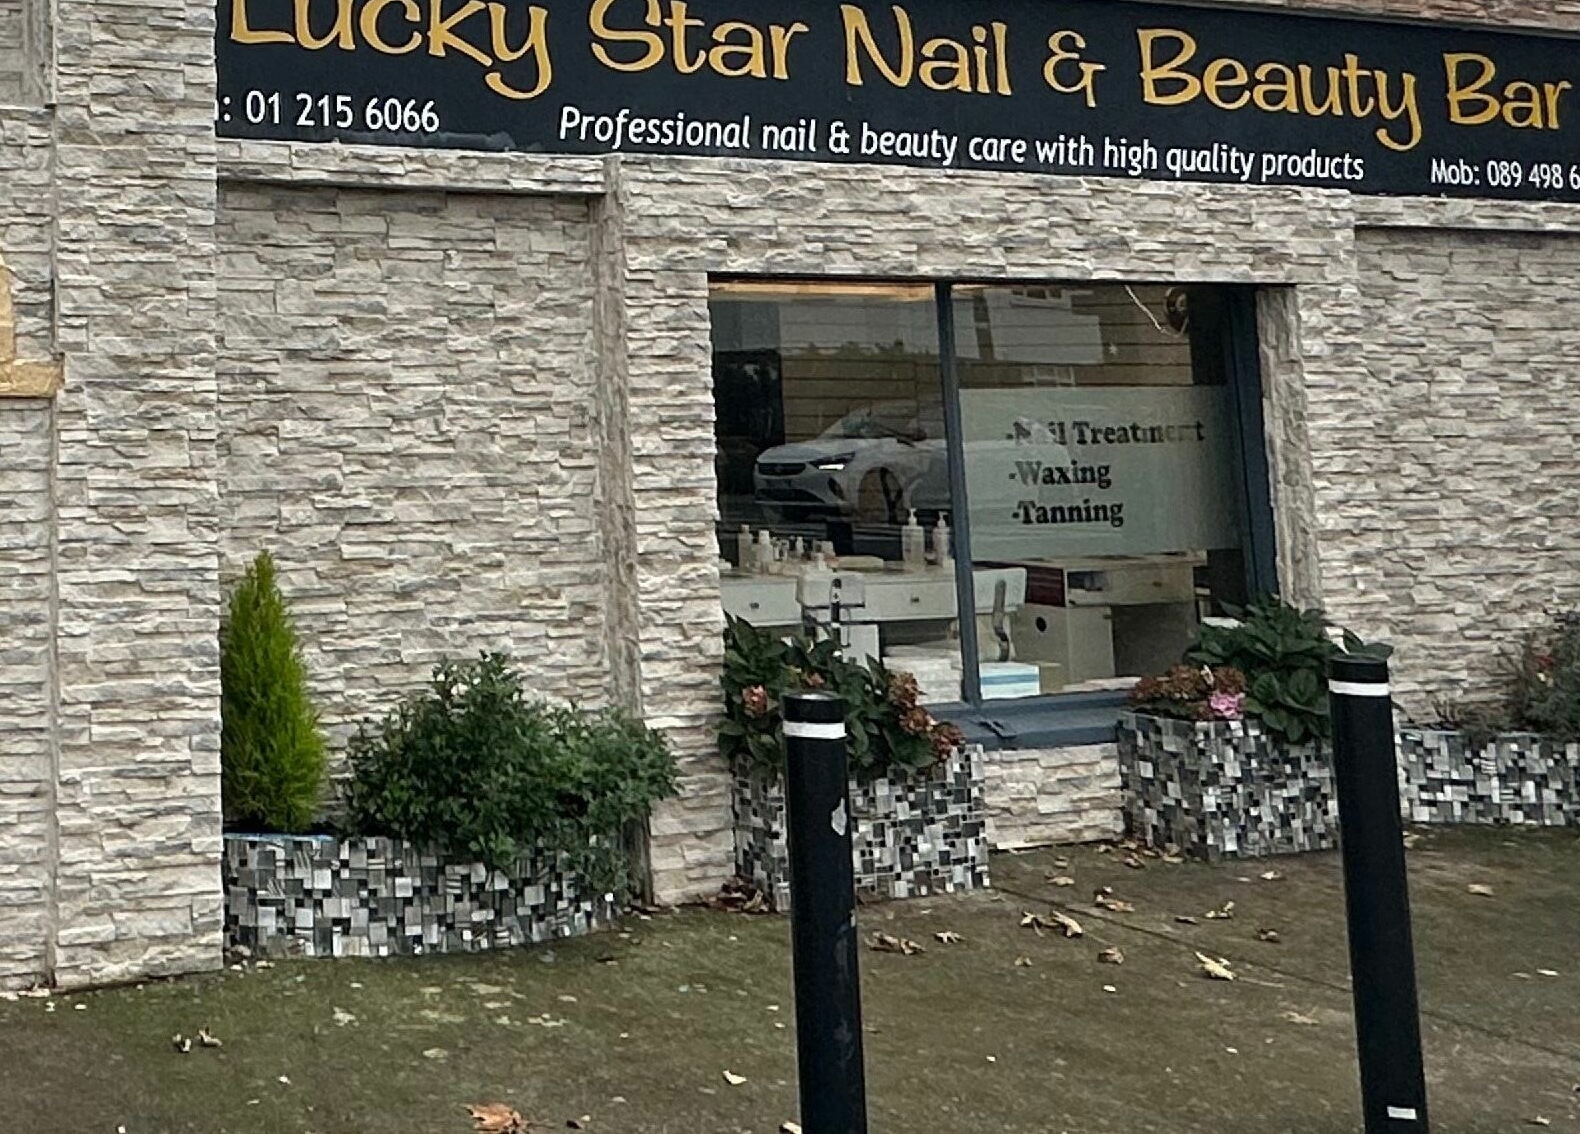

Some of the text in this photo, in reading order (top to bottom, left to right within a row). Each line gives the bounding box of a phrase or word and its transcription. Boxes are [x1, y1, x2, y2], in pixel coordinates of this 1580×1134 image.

[840, 4, 1011, 95] Nail
[1044, 30, 1105, 107] &
[1137, 28, 1422, 151] Beauty
[1443, 52, 1571, 129] Bar
[246, 90, 280, 124] 01
[296, 93, 353, 128] 215
[365, 97, 440, 132] 6066
[559, 106, 1364, 181] Professional nail & beauty care with high quality products
[1431, 157, 1480, 185] Mob:
[1487, 160, 1521, 187] 089
[1528, 163, 1564, 189] 498
[1006, 421, 1067, 445] -Nil
